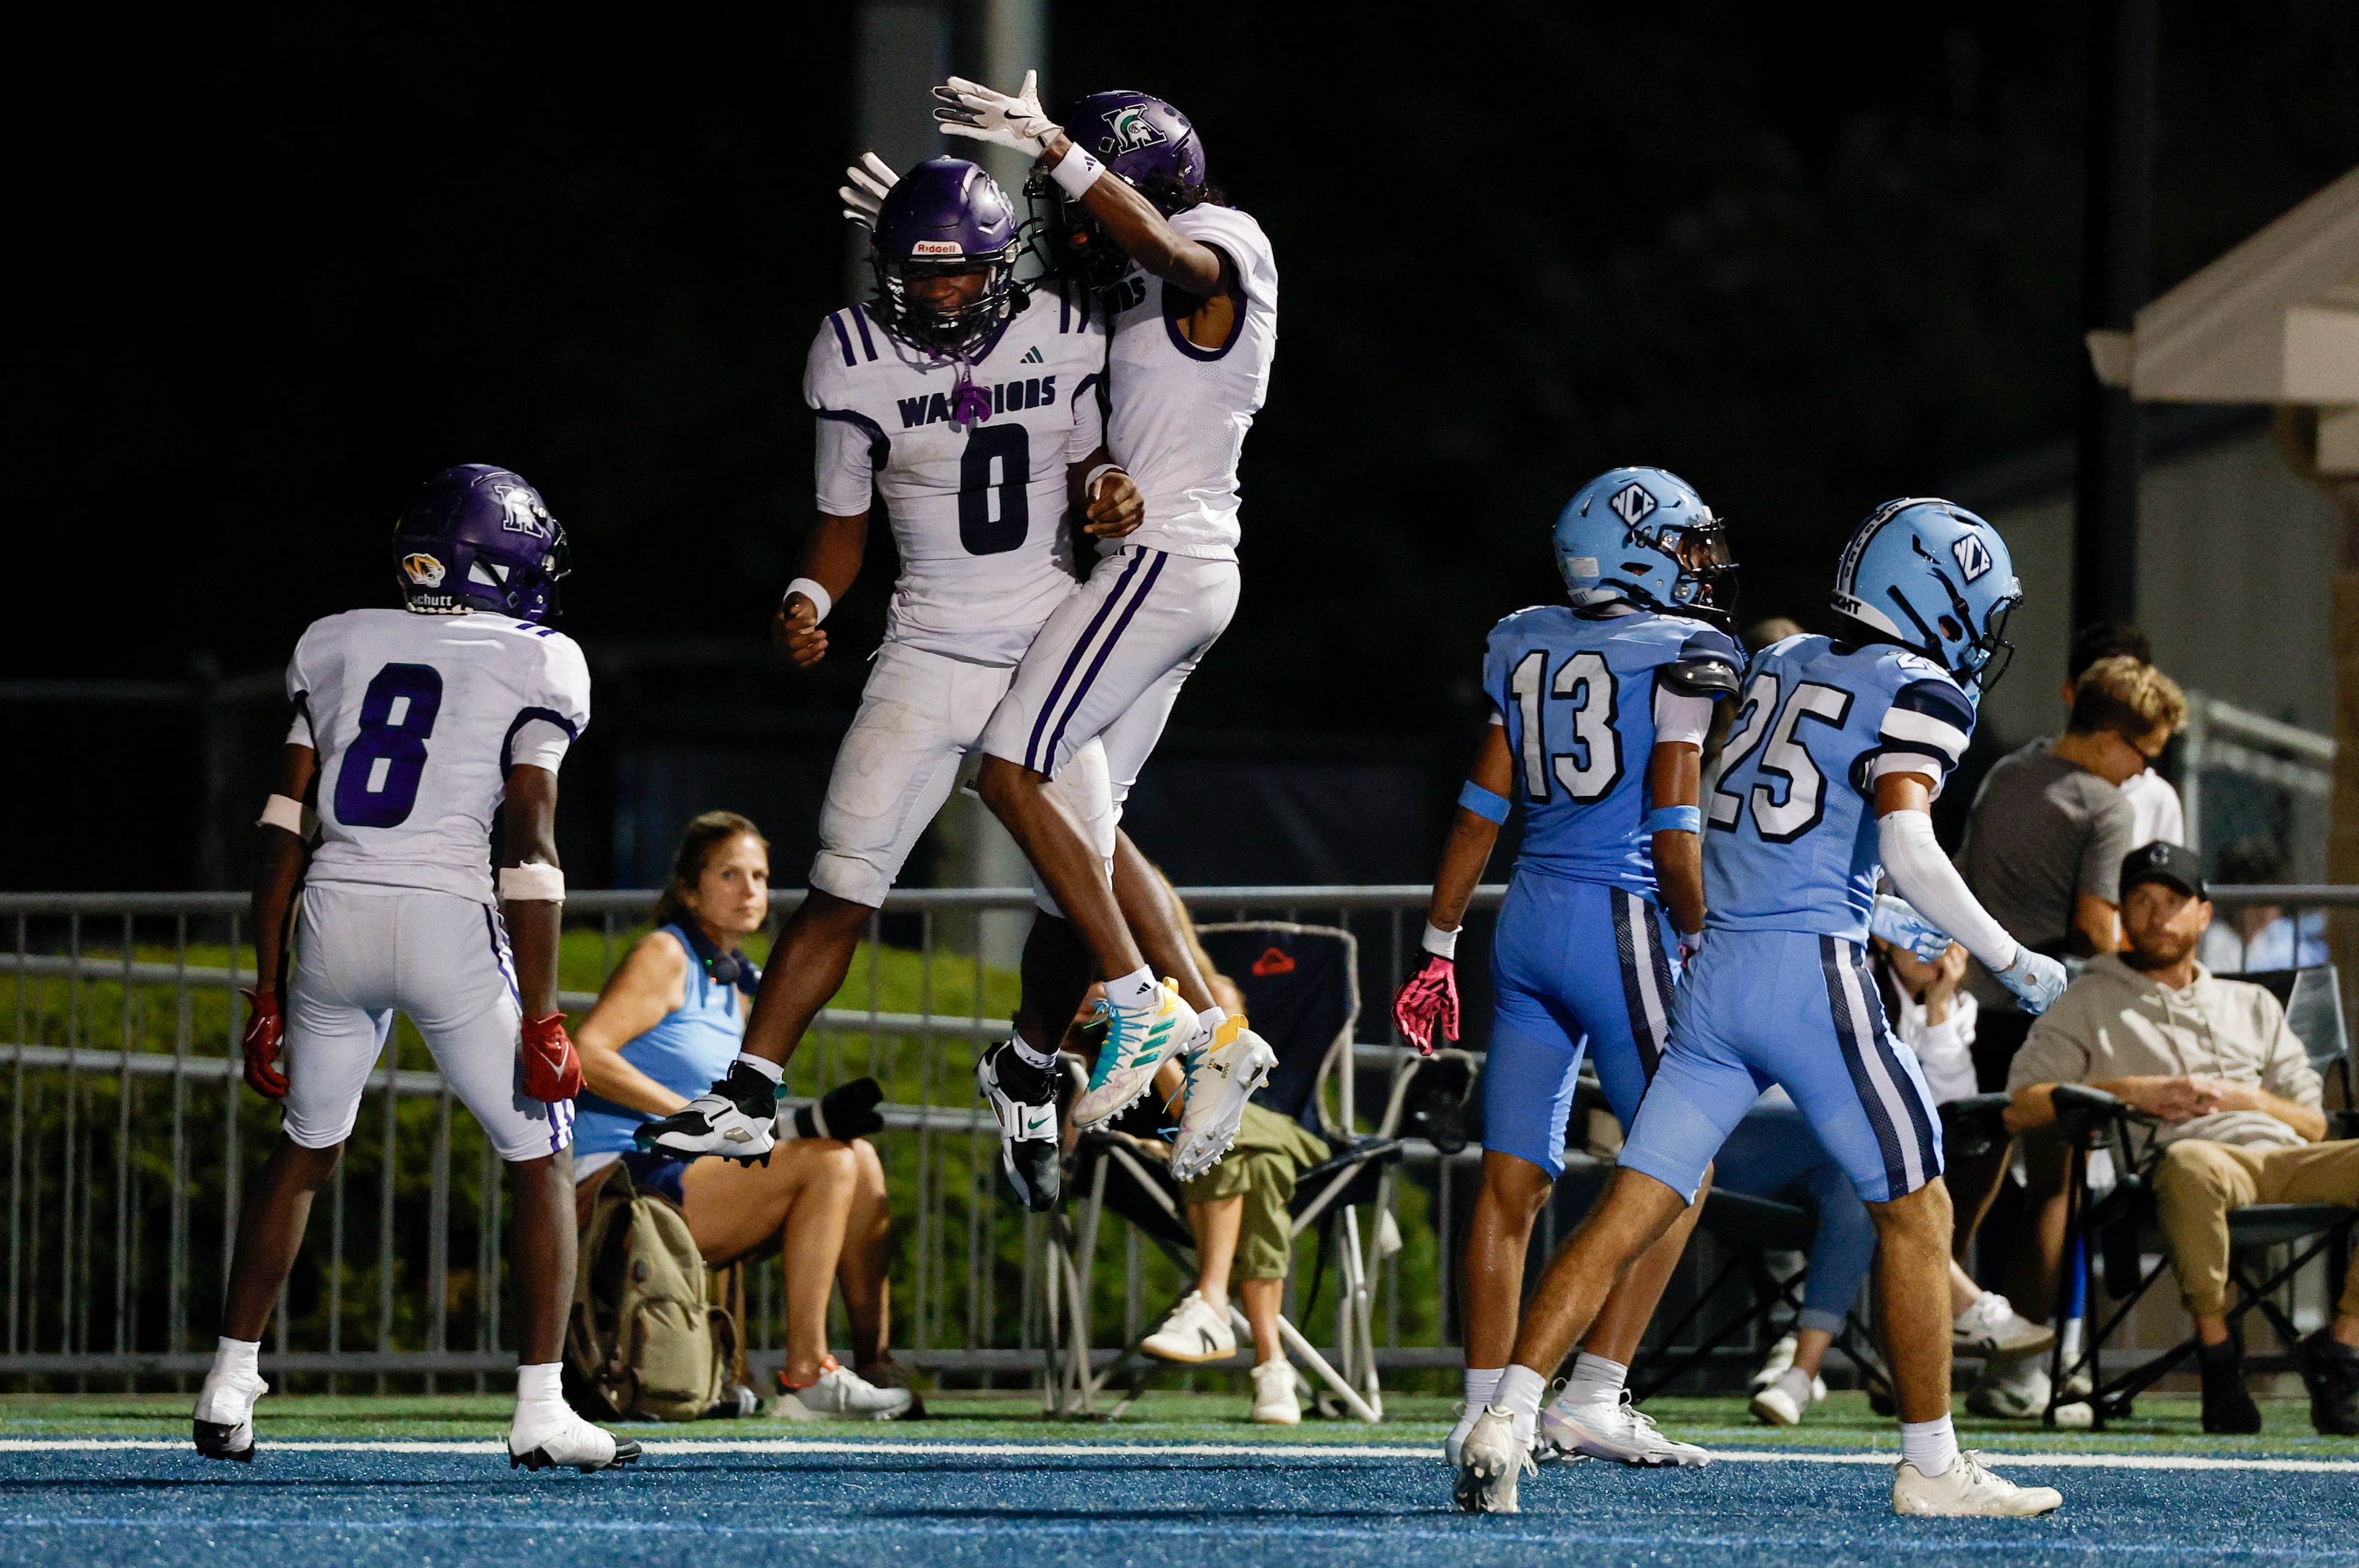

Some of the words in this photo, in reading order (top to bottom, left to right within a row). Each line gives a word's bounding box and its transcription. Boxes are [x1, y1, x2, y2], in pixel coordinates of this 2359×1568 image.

[897, 375, 1056, 429] WAIORS
[957, 423, 1030, 556] 0
[1611, 483, 1655, 527] NCC
[1954, 533, 1990, 582] NCC
[412, 593, 453, 607] schutt
[333, 662, 443, 829] 8
[1509, 649, 1626, 805] 13
[1707, 671, 1856, 844] 25
[1221, 1062, 1230, 1079] GOOD
